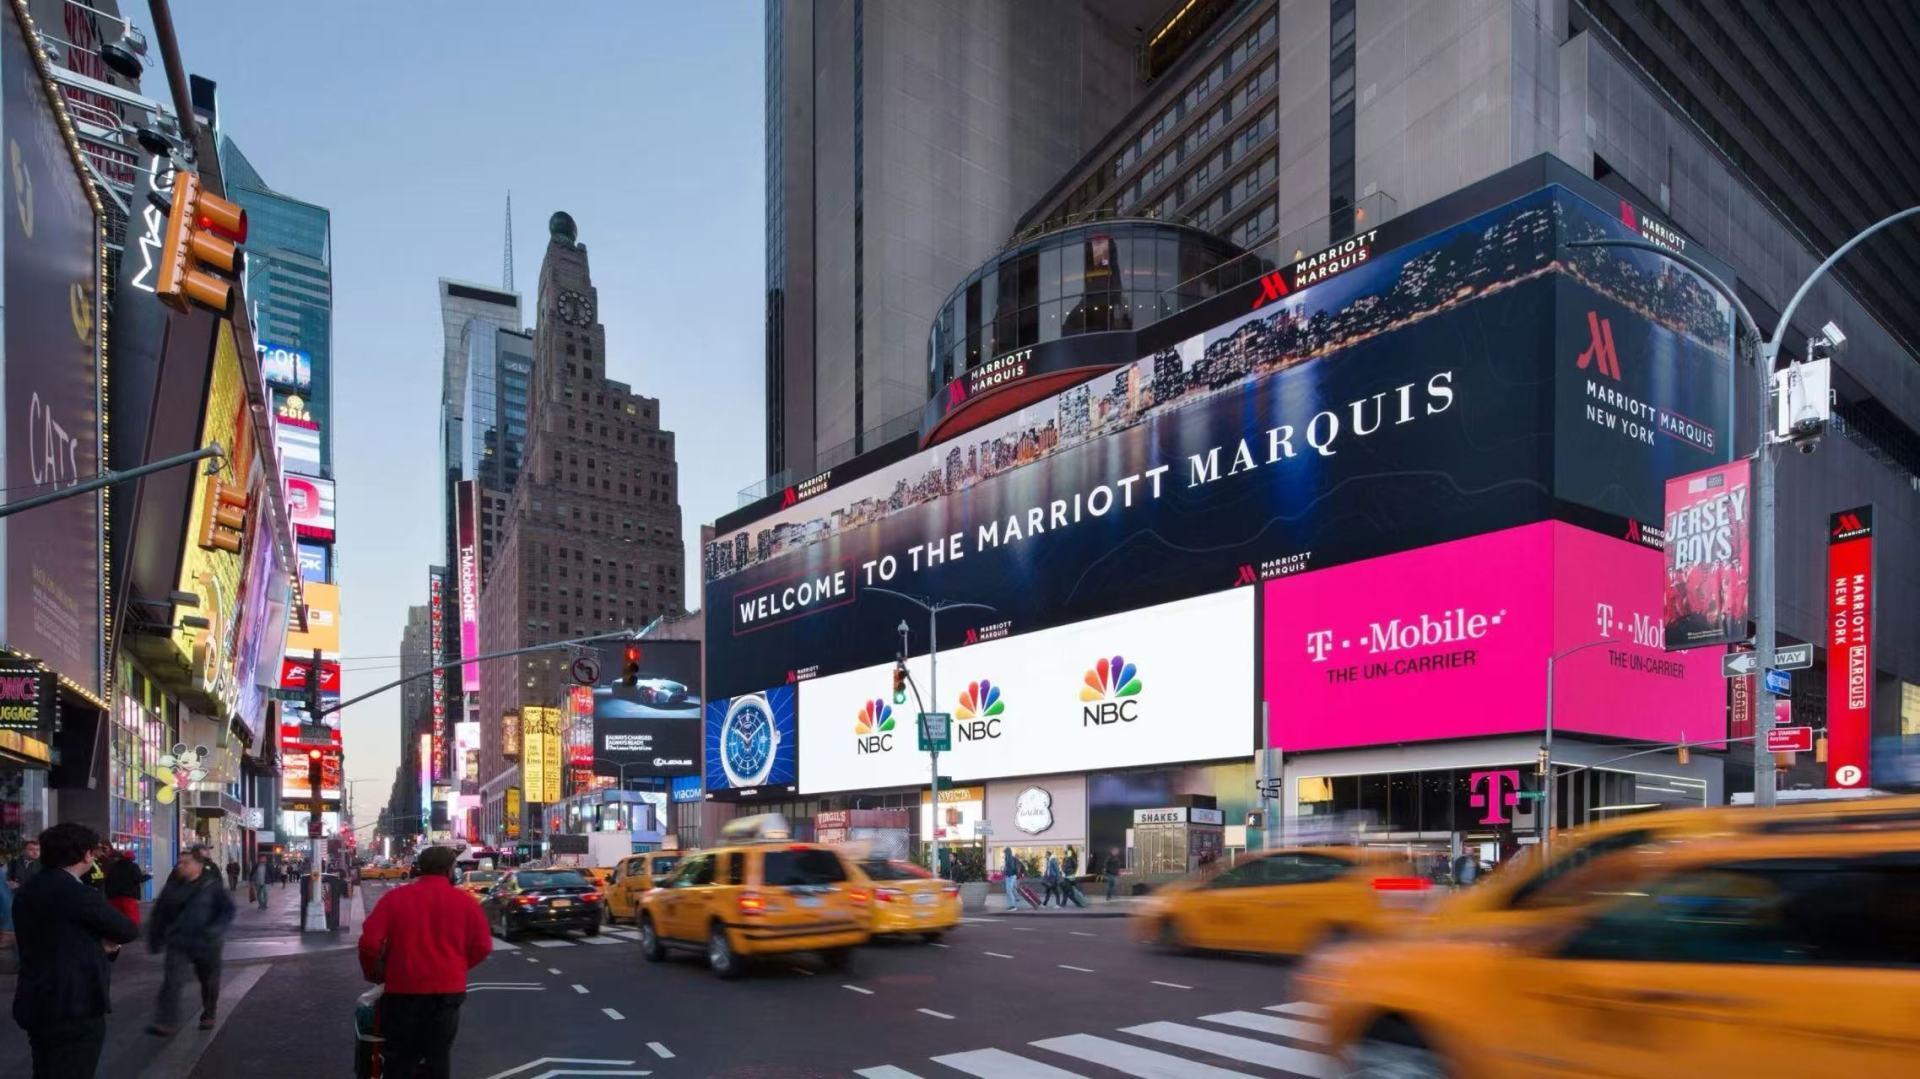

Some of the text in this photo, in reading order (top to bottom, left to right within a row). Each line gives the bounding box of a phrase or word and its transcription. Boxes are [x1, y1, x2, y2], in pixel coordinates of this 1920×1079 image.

[1642, 216, 1686, 250] MARRIOTT
[1296, 230, 1377, 274] MARRIOTT
[1296, 249, 1367, 287] MARQUIS
[971, 349, 1032, 381] MARRIOTT
[971, 365, 1024, 393] MARQUIS
[279, 405, 312, 421] 2016
[1586, 379, 1714, 448] MARRIOTT MARQUIS
[1586, 404, 1656, 447] NEW YORK
[29, 392, 78, 491] CATS
[798, 471, 831, 491] MARRIOTT
[798, 481, 828, 500] MARQUIS
[740, 370, 1453, 625] WELCOME TO THE MARRIOTT MARQUIS
[1666, 487, 1747, 542] JERSEY
[1642, 524, 1665, 538] MARRIO
[1642, 535, 1665, 548] MARQU
[1838, 527, 1871, 538] MARRIOTT
[1261, 551, 1312, 569] MARRIOTT
[1676, 526, 1733, 570] BOYS
[1261, 562, 1306, 579] MARQUIS
[1835, 577, 1847, 645] NEW YORK
[980, 620, 1012, 632] MARRIOTT
[980, 628, 1009, 640] MARQUIS
[1852, 574, 1865, 707] MARRIOTT MARQUIS
[1327, 650, 1476, 685] THE UN-CARRIER
[1608, 650, 1684, 679] THE UN-CARRIER
[1776, 653, 1801, 663] WAY
[1083, 698, 1138, 727] NBC
[857, 733, 893, 755] NBC
[958, 719, 1002, 742] NBC
[1844, 770, 1854, 782] P
[1470, 770, 1520, 824] T
[817, 811, 847, 824] VIRGIL'S
[1141, 812, 1178, 823] SHAKES
